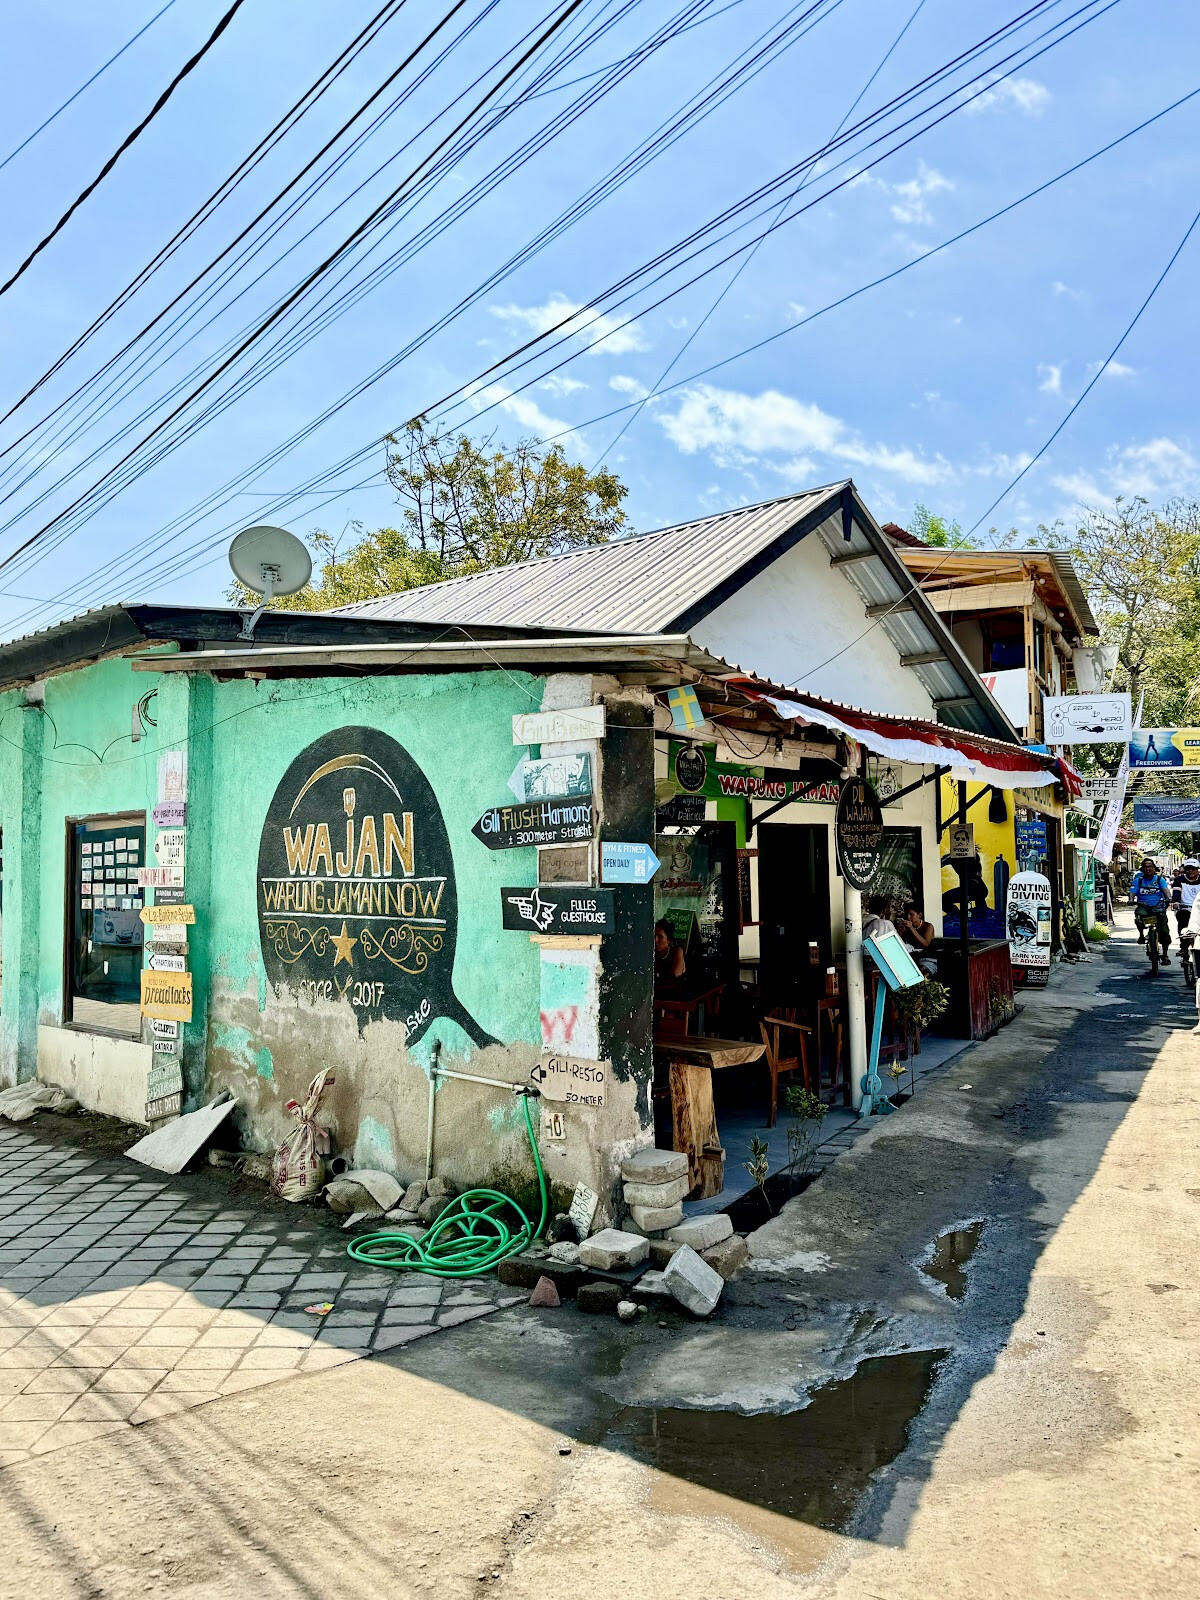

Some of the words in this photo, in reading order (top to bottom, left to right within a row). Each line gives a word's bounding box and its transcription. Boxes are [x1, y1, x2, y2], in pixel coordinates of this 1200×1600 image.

[717, 774, 786, 799] WARUNG
[1085, 789, 1110, 797] STOP
[541, 802, 592, 827] Harmony
[283, 812, 415, 878] WAJAN
[623, 846, 646, 854] FITNESS
[603, 858, 617, 868] OPEN
[617, 858, 630, 868] DAILY
[262, 881, 325, 912] WARUNG
[326, 881, 382, 914] JAMAN
[384, 881, 446, 917] NOW
[1012, 891, 1050, 900] DIVING
[570, 900, 597, 911] FULLES
[561, 912, 606, 924] GUESTHOUSE
[353, 981, 385, 1008] 2017
[565, 1092, 579, 1102] 50
[580, 1095, 603, 1106] METER
